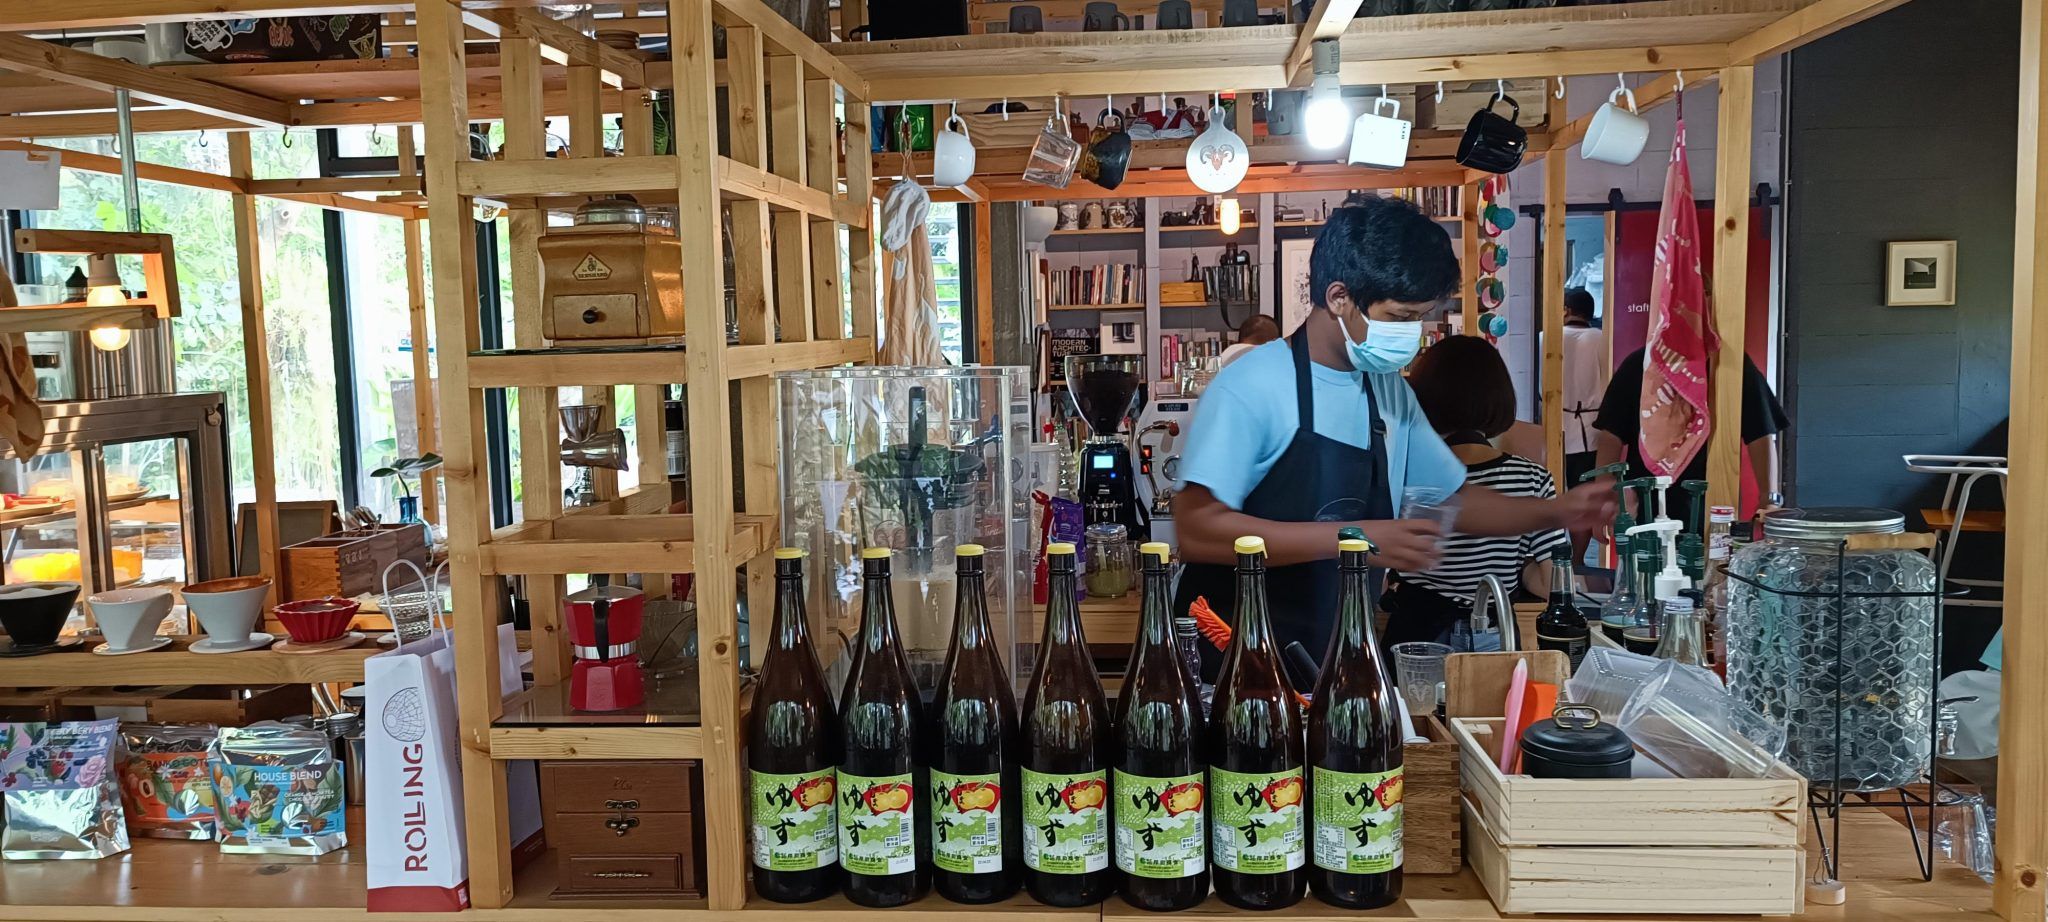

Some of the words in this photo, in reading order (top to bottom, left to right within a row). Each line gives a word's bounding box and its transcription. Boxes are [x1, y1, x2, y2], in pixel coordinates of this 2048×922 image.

[254, 772, 288, 782] HOUSE
[290, 770, 322, 781] BLEND
[404, 743, 428, 872] ROLLING
[766, 783, 797, 846] ゆず
[843, 784, 867, 847] ゆず
[932, 781, 954, 843] ゆず
[1035, 783, 1065, 847] ゆず
[1132, 786, 1163, 851] ゆず
[1233, 782, 1266, 848] ゆず
[1344, 782, 1377, 848] ゆず
